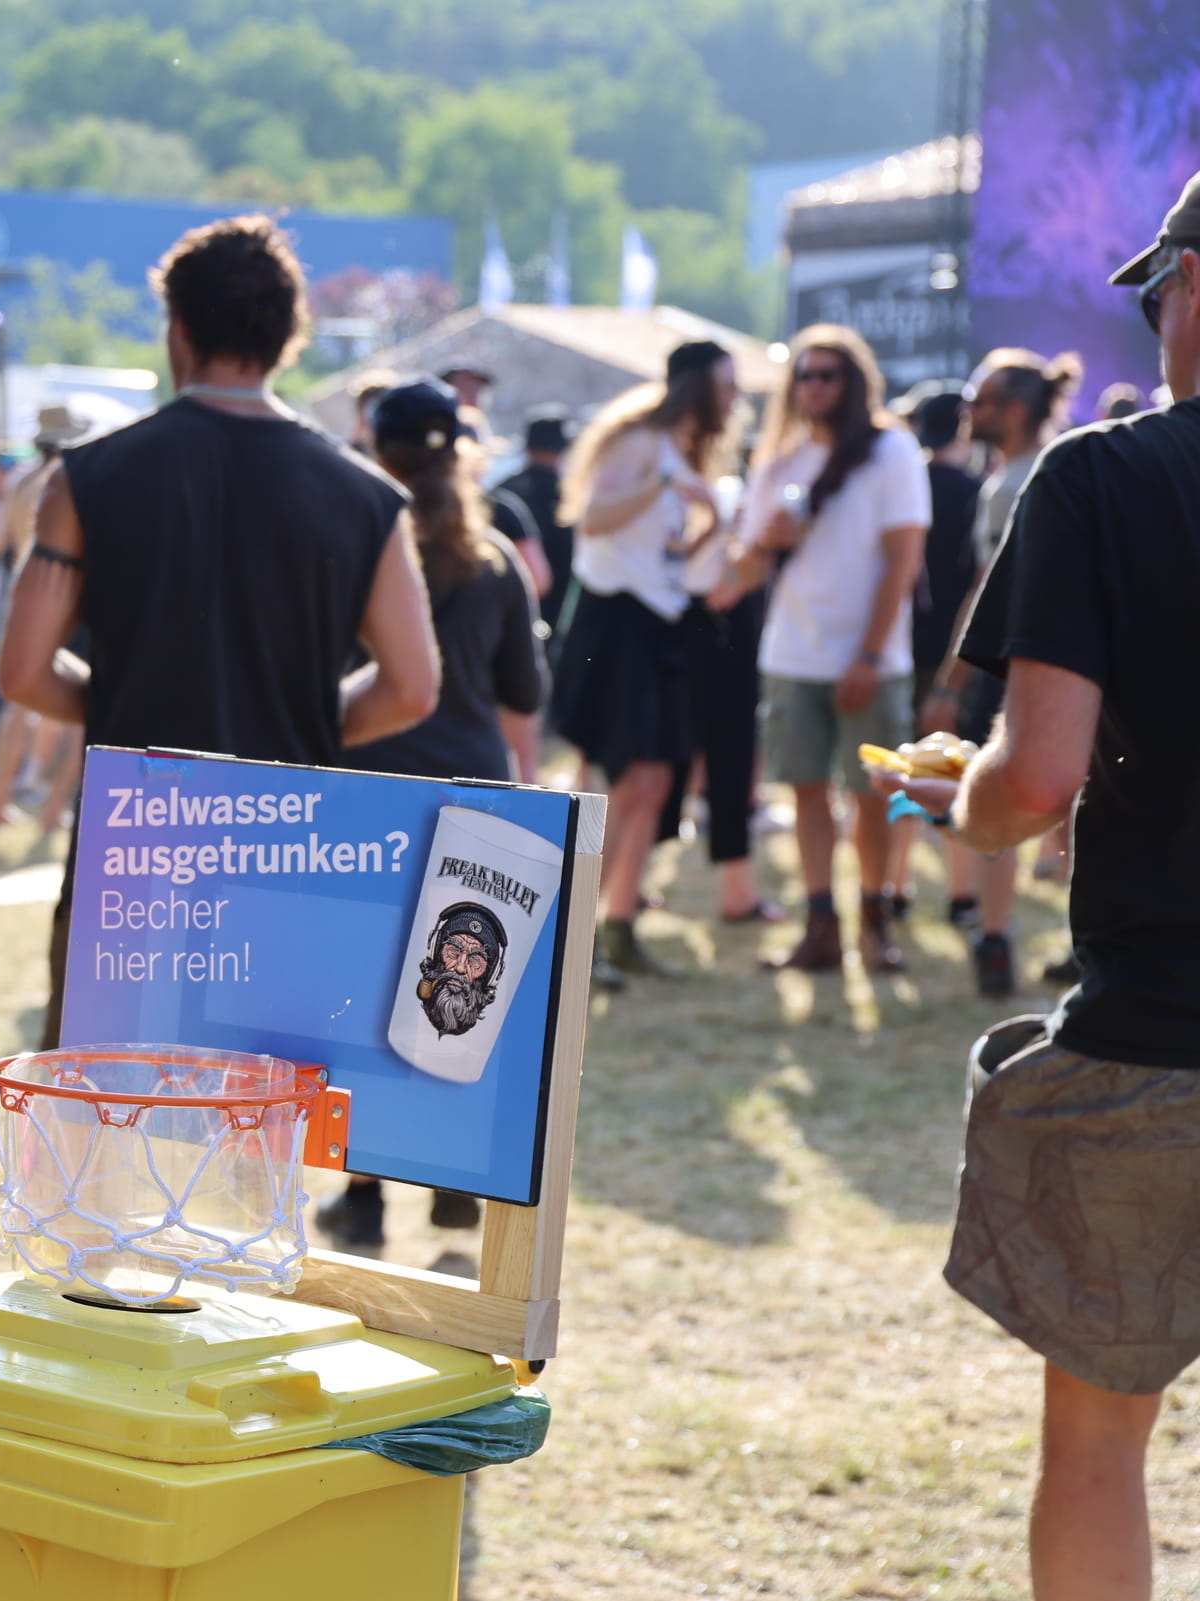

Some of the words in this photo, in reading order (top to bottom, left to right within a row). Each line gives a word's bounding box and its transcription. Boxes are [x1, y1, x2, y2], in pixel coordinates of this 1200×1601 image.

[107, 787, 322, 828] Zielwasser
[103, 831, 410, 885] ausgetrunken?
[437, 856, 490, 879] FREAK
[491, 868, 541, 917] VALLEY
[460, 875, 512, 905] FESTIVAL
[101, 889, 230, 930] Becher
[96, 941, 163, 982] hier
[172, 941, 251, 982] rein!
